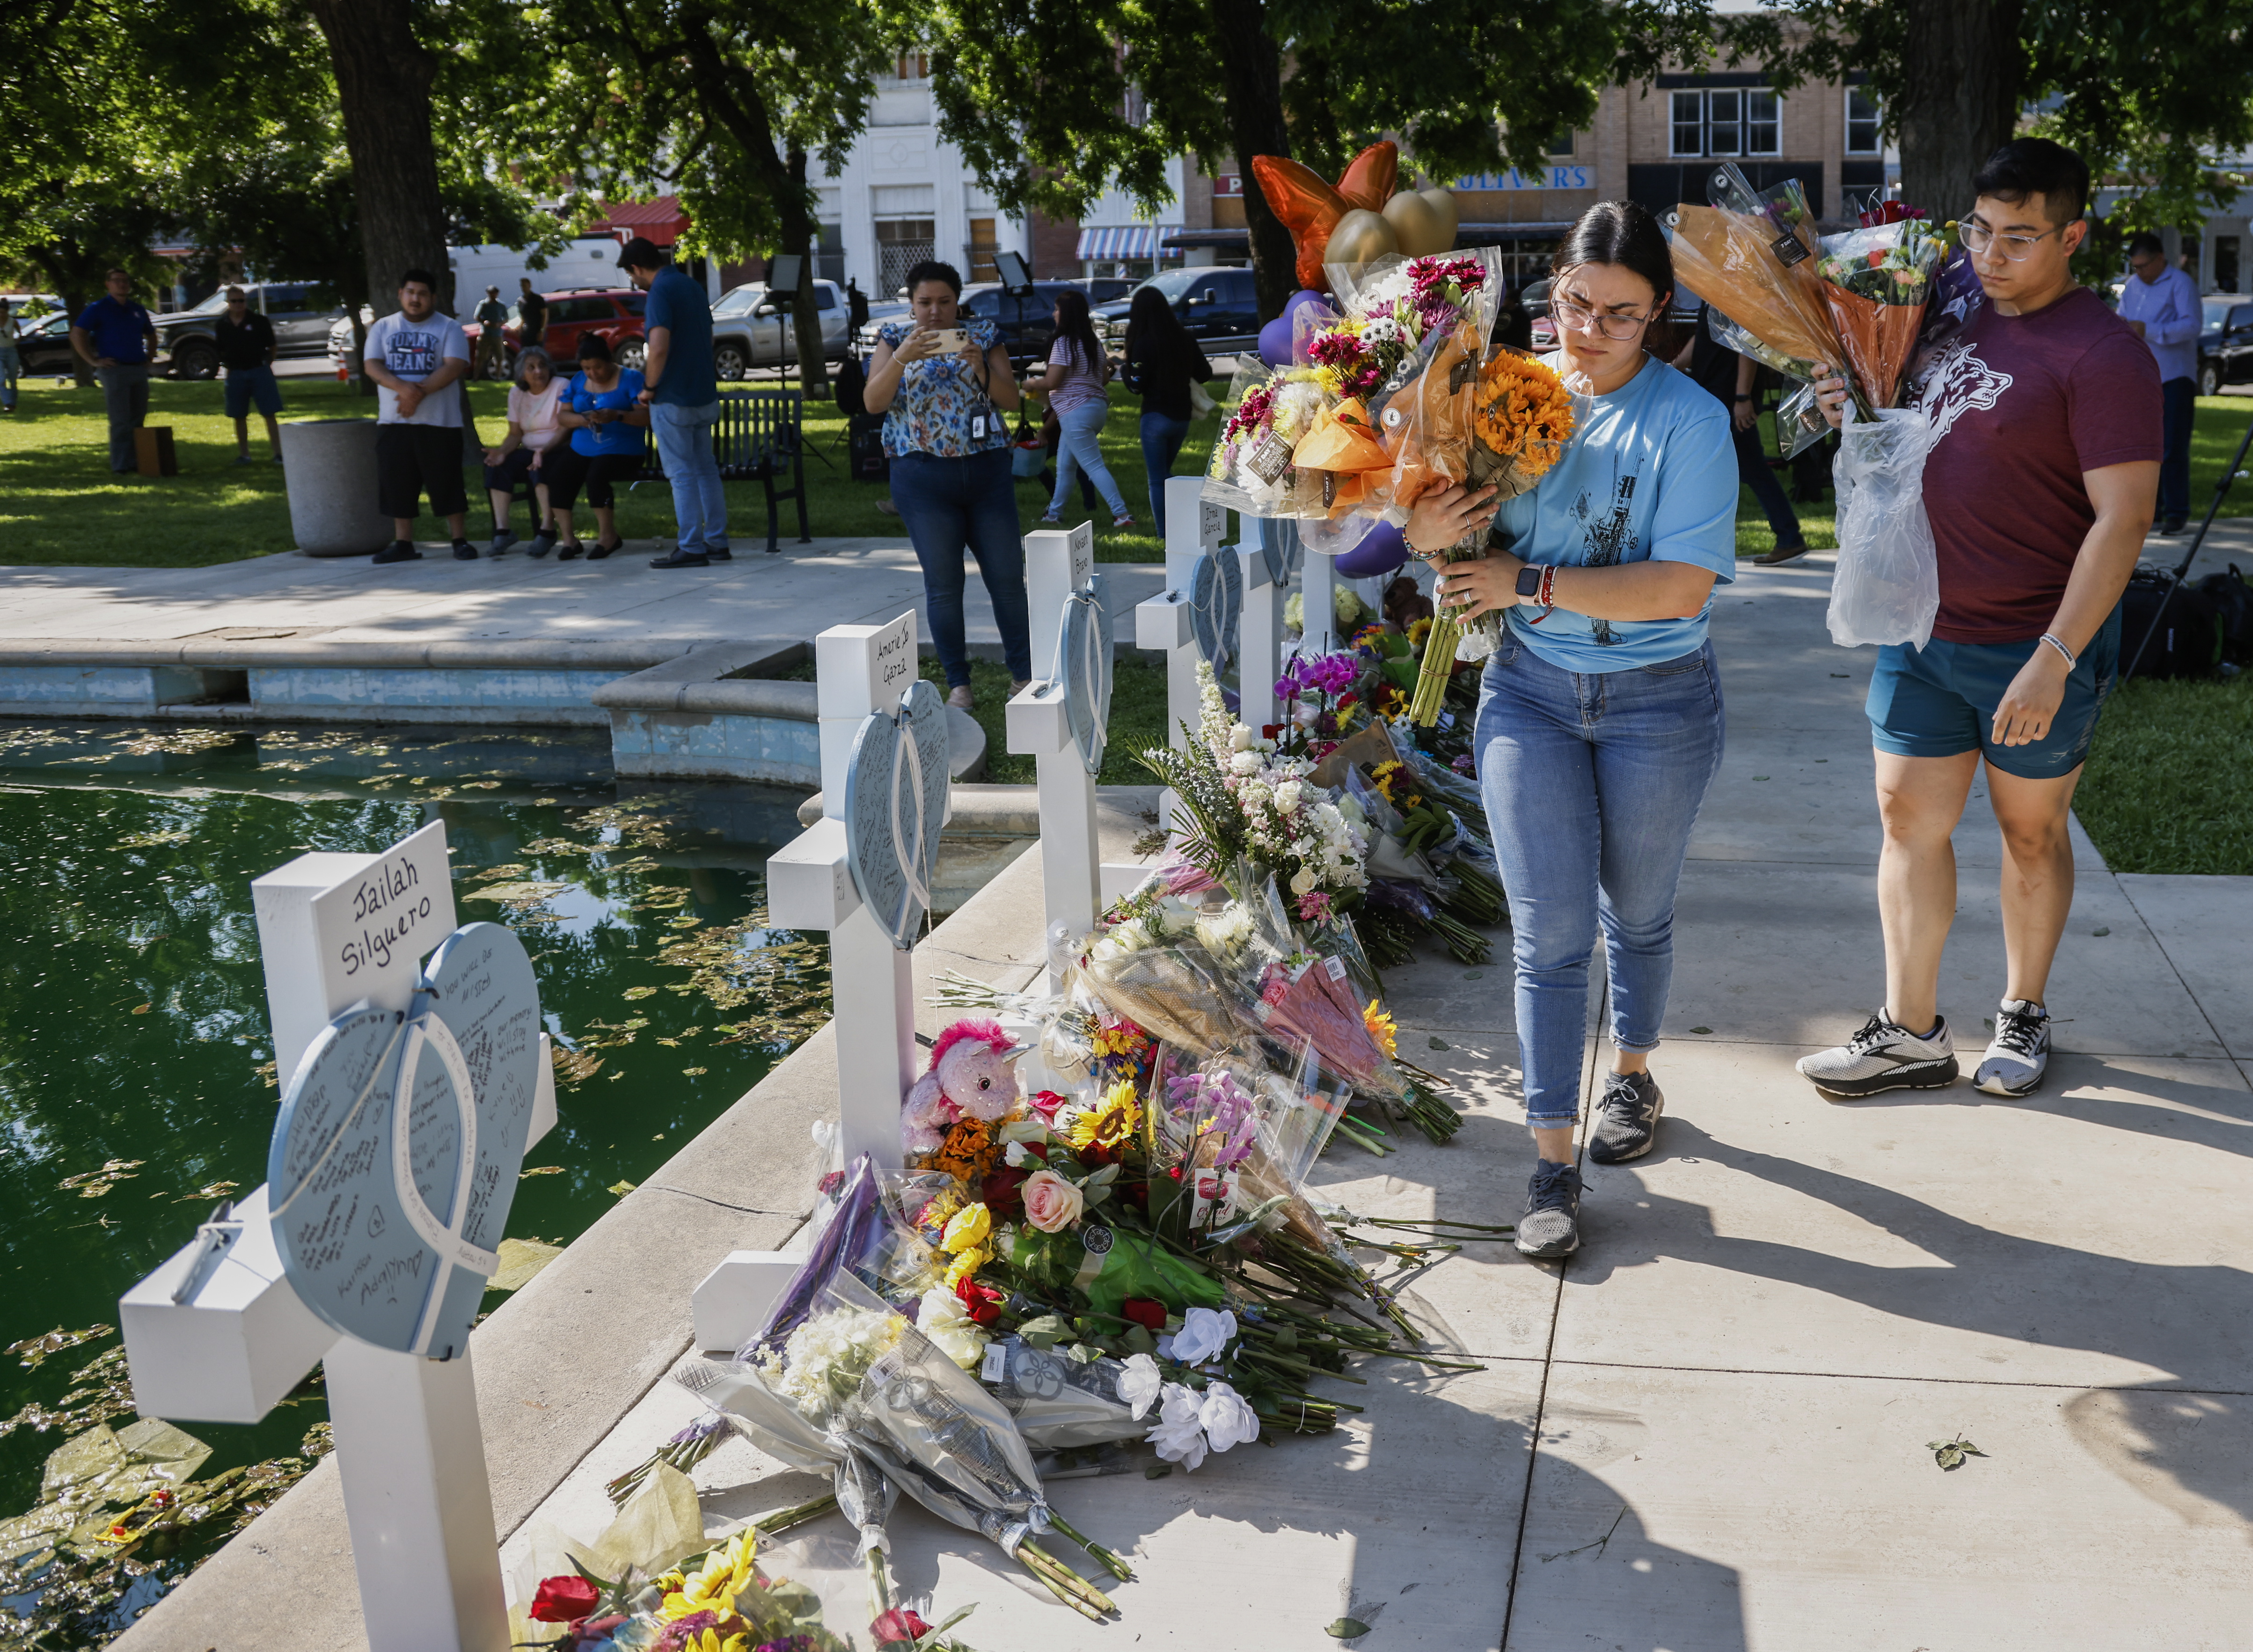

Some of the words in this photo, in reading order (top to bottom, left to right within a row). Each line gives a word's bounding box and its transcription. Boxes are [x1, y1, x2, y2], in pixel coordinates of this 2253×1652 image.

[1459, 166, 1587, 189] OLIVR'S
[386, 332, 439, 351] TOMMY
[386, 352, 434, 370] JEANS
[1258, 445, 1280, 470] FRESHNESS
[1260, 447, 1271, 459] DAY
[1262, 446, 1286, 474] GUARANTEE
[1206, 507, 1218, 520] Irma
[1205, 520, 1221, 535] Garcia
[1075, 529, 1088, 552] Nevaeh
[1075, 557, 1088, 574] Bravo
[877, 635, 900, 661] Amerie
[901, 621, 908, 649] Jo
[2059, 643, 2073, 662] DEMAND
[884, 658, 907, 686] Garza
[353, 857, 418, 922] Jailah
[342, 897, 430, 975] Silguero
[444, 979, 459, 1001] YOU
[461, 958, 479, 982] WILL
[497, 1021, 508, 1036] our
[497, 1030, 511, 1049] will
[512, 1027, 526, 1042] stay
[498, 1046, 515, 1063] with
[410, 1121, 425, 1135] with
